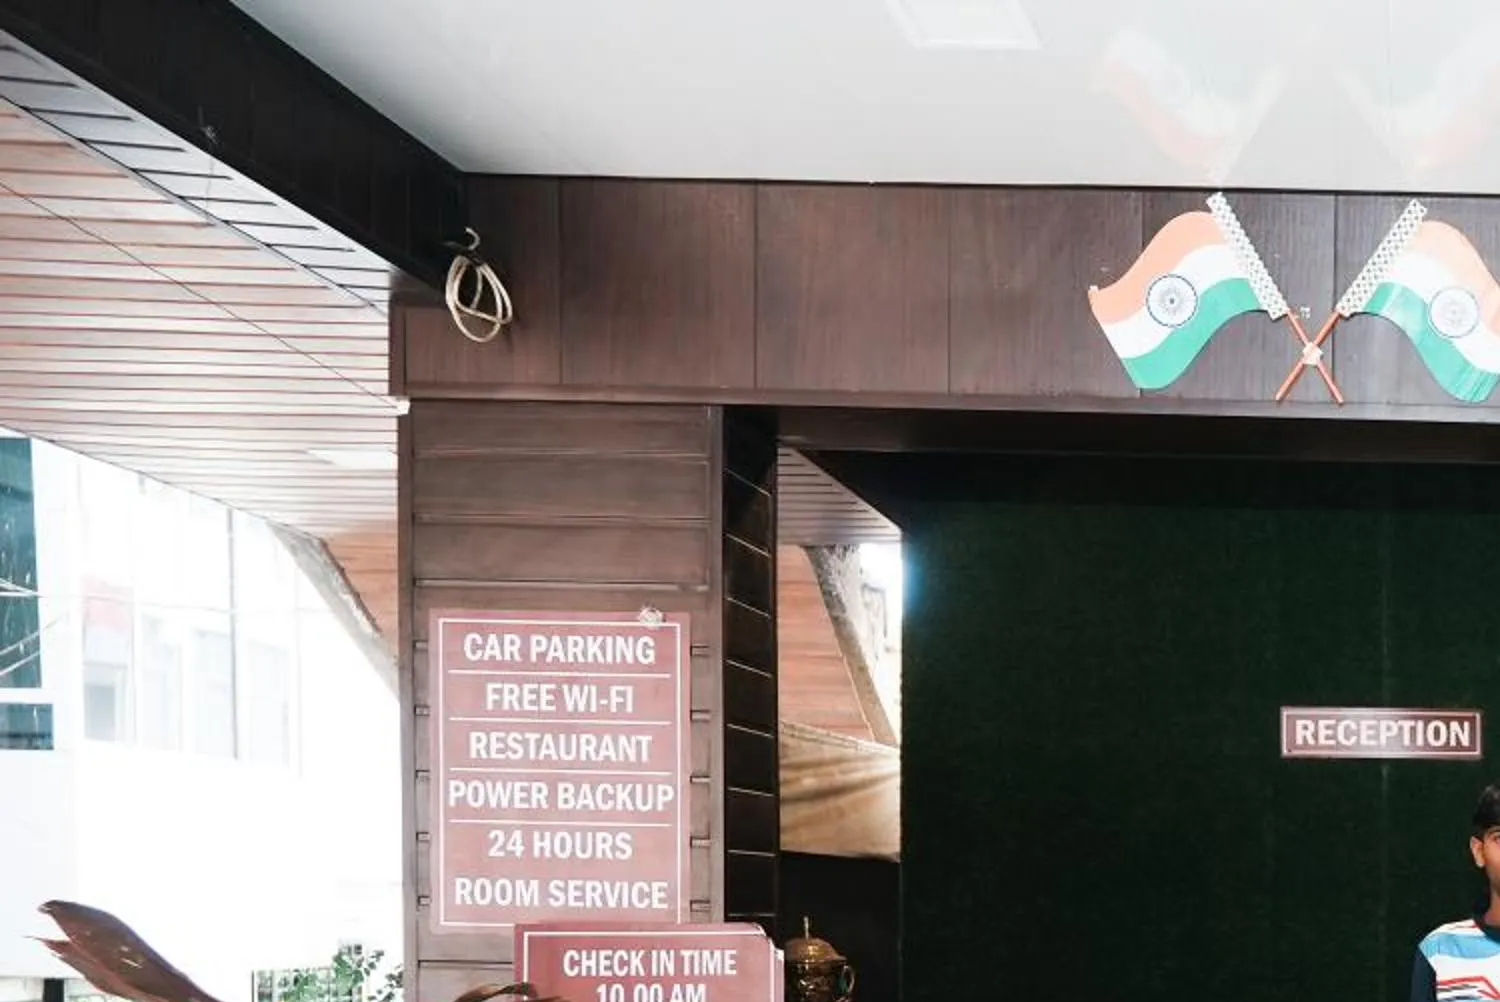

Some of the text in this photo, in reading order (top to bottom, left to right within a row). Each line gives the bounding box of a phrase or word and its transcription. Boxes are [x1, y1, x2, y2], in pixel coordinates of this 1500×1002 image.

[463, 632, 656, 664] CAR PARKING
[485, 683, 634, 713] FREE WI-FI
[469, 731, 652, 762] RESTAURANT
[1295, 719, 1470, 747] RECEPTION
[449, 780, 674, 812] POWER BACKUP
[488, 829, 633, 860] 24 HOURS
[455, 878, 669, 909] ROOM SERVICE
[563, 949, 737, 977] CHECK IN TIME
